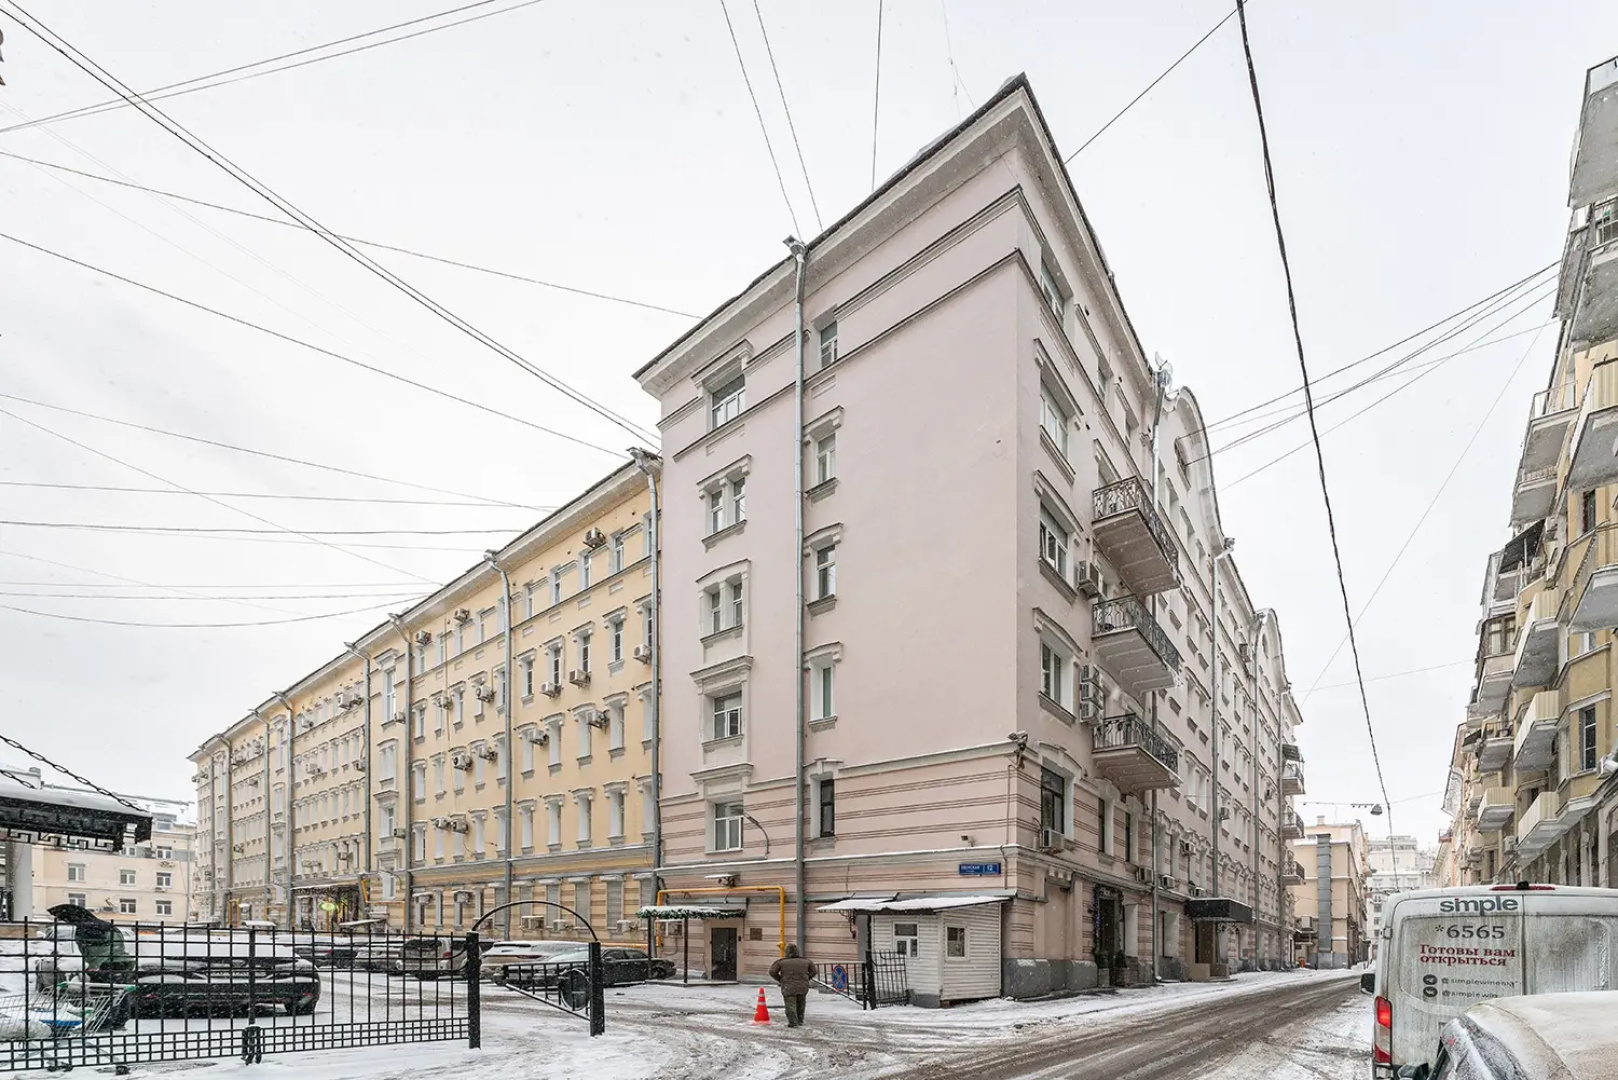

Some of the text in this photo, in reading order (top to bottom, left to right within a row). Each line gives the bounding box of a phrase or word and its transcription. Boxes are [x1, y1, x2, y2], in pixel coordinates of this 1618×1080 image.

[1440, 896, 1518, 916] simple
[1420, 944, 1516, 958] Готовы вам
[1420, 955, 1507, 967] открыться
